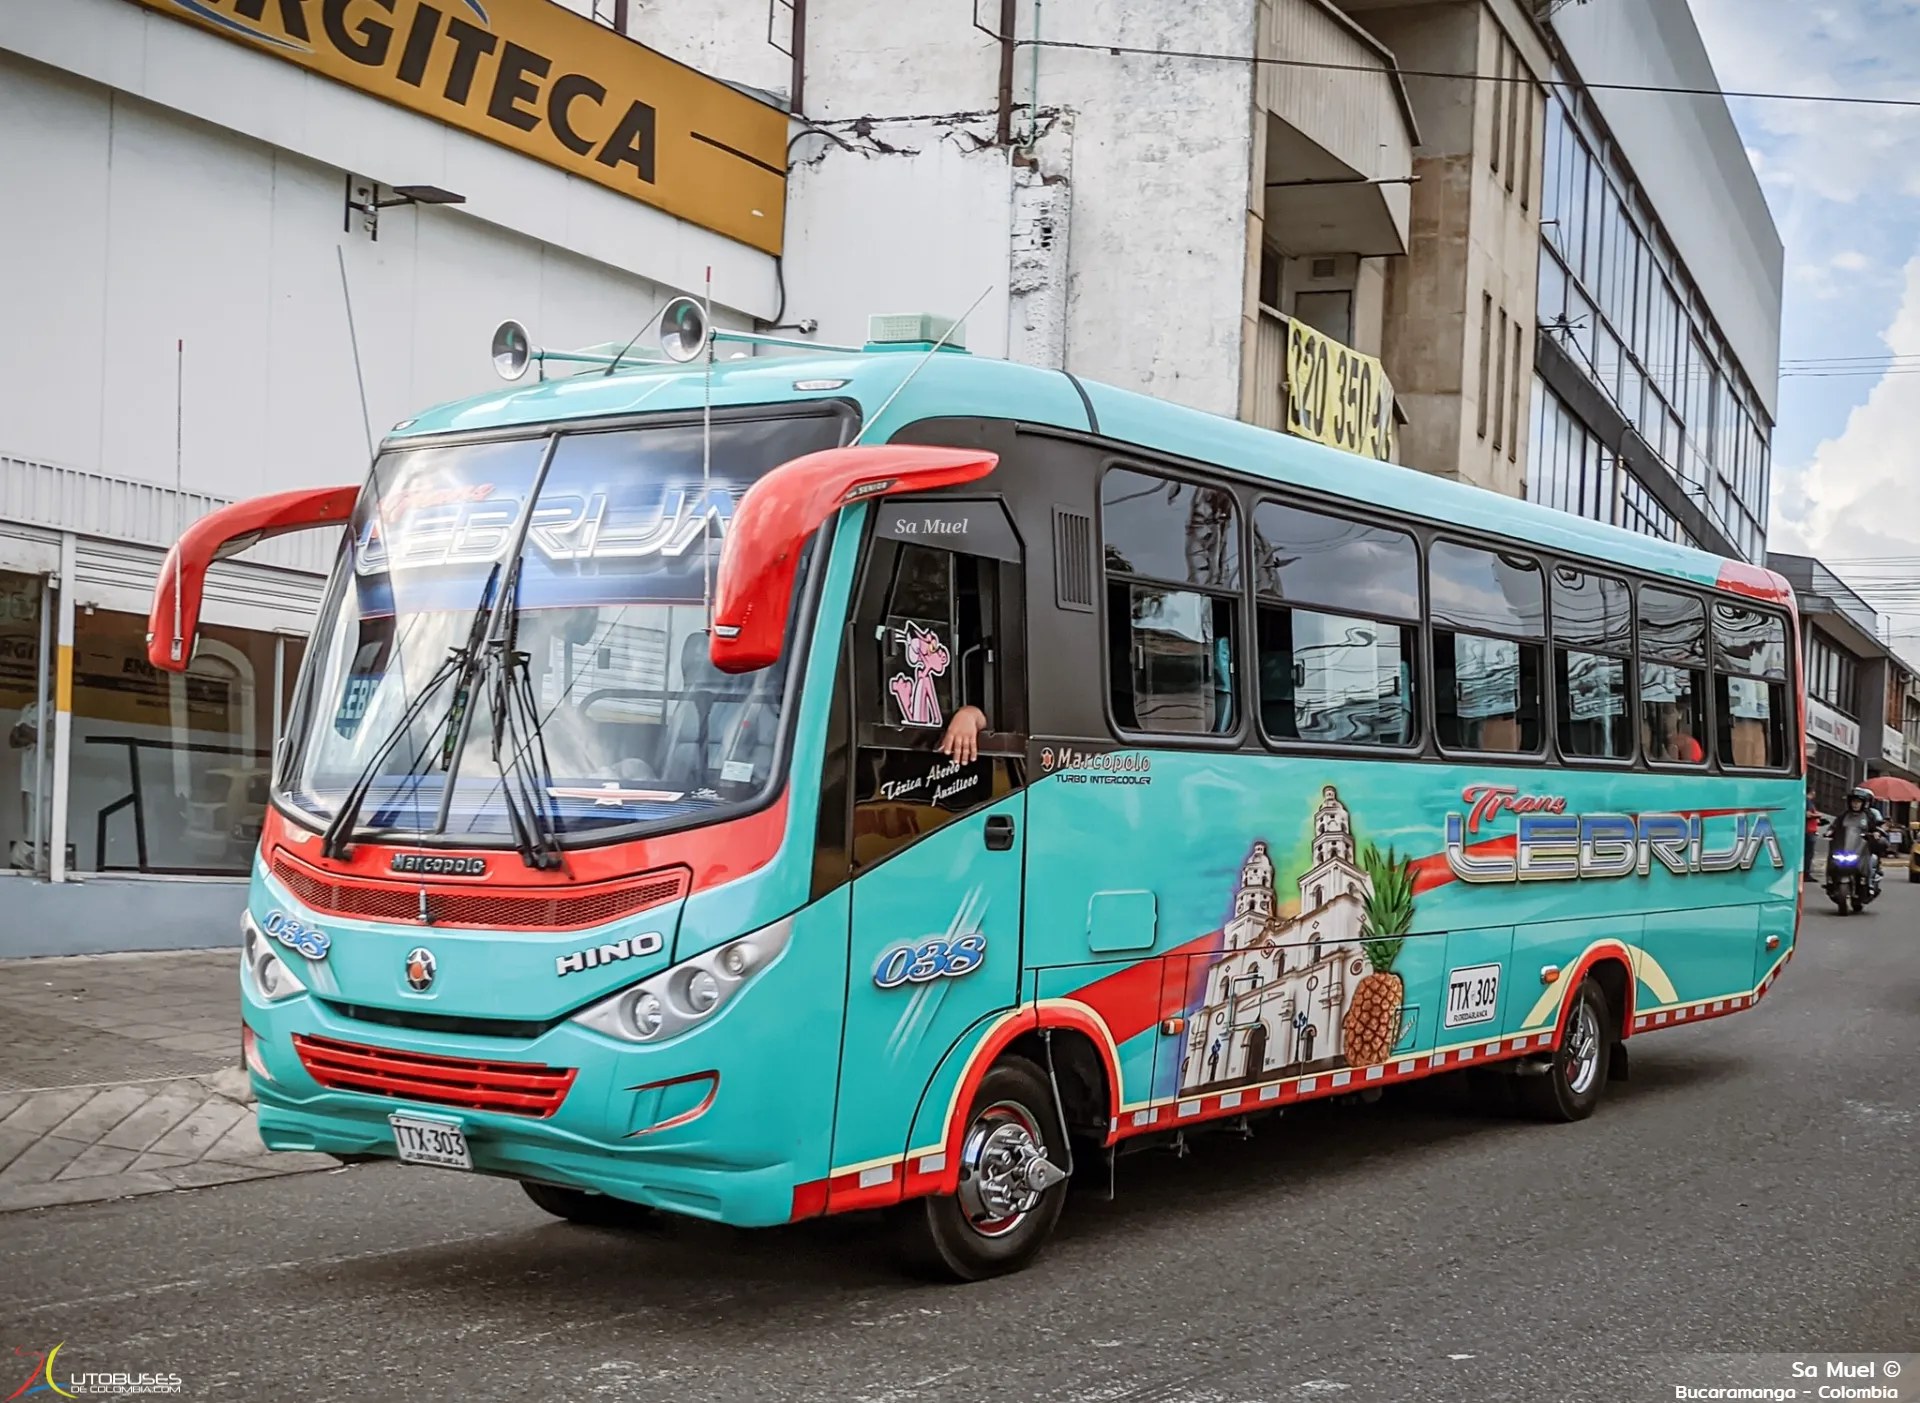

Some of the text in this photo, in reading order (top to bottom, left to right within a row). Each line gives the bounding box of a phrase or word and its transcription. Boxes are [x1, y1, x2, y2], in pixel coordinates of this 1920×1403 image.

[1055, 774, 1152, 785] TURBO INTERCOOLER
[1057, 747, 1151, 773] Marcopolo
[1462, 784, 1567, 833] Trans
[392, 853, 485, 874] Marcopolo
[1444, 811, 1784, 884] LEBRIJA
[263, 909, 332, 960] 038
[555, 931, 664, 977] HINO
[874, 934, 987, 988] 038
